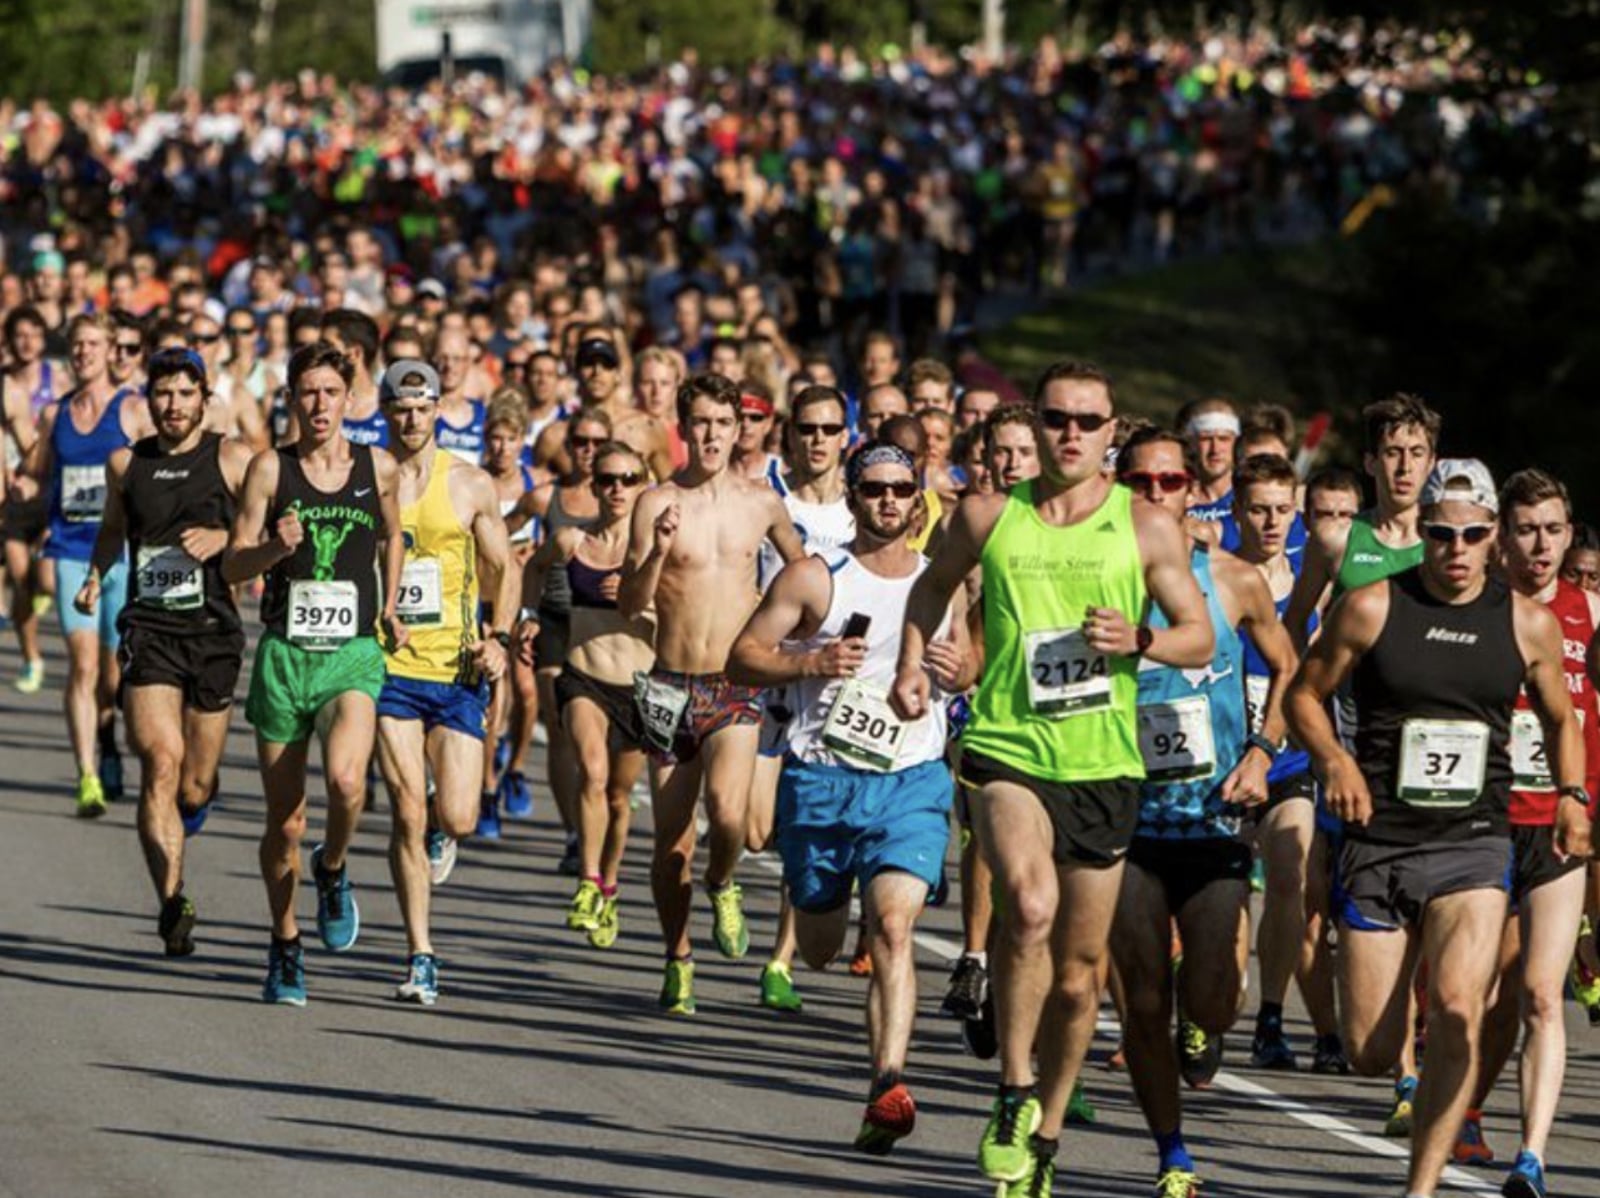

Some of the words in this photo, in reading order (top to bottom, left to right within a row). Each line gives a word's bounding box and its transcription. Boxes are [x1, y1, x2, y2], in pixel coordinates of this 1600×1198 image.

[142, 568, 198, 589] 3984
[294, 605, 352, 626] 3970
[1034, 655, 1106, 687] 2124
[834, 704, 901, 746] 3301
[1153, 731, 1189, 758] 92
[1424, 751, 1462, 776] 37
